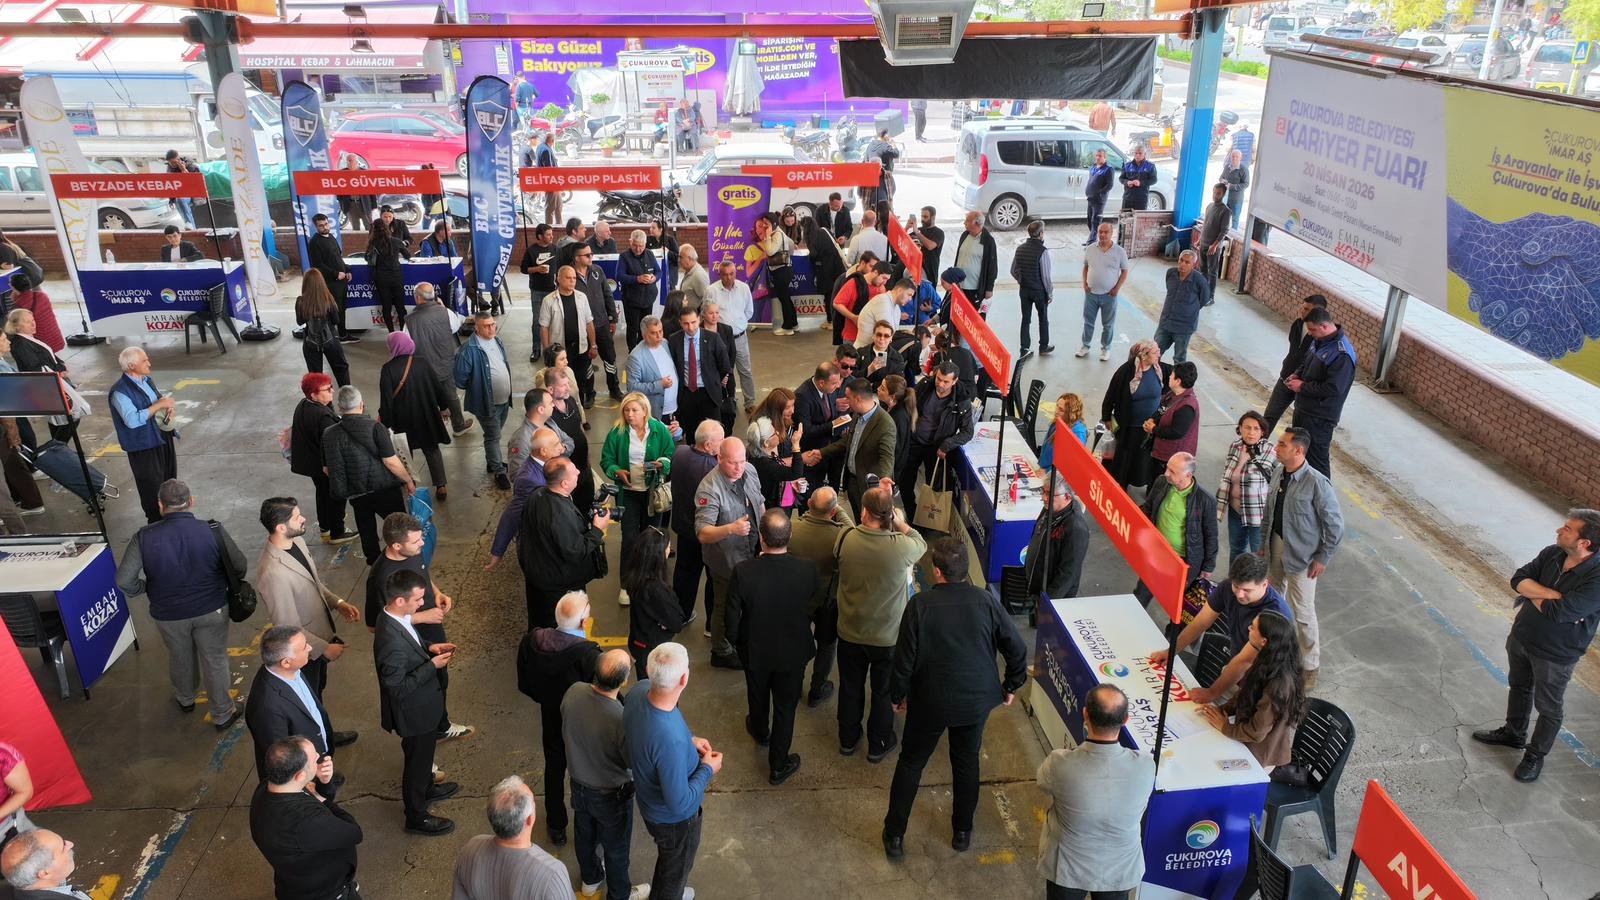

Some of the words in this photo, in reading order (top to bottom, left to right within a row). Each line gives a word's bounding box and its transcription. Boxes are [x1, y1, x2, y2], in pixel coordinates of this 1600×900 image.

[521, 40, 554, 54] Size
[558, 40, 602, 54] Güzel
[301, 57, 330, 66] KEBAP
[346, 57, 394, 66] LAHMACUN
[1492, 146, 1501, 166] İş
[1503, 154, 1563, 180] Arayanlar
[1566, 168, 1580, 184] ile
[1576, 152, 1592, 166] AŞ
[1362, 144, 1428, 190] FUARI
[321, 178, 347, 188] BLC
[350, 174, 416, 188] GÜVENLİK
[525, 174, 565, 186] ELİTAŞ
[568, 176, 600, 184] GRUP
[602, 172, 651, 184] PLASTİK
[787, 170, 833, 182] GRATİS
[1302, 162, 1315, 177] 20
[1315, 165, 1347, 189] NİSAN
[1348, 178, 1375, 200] 2026
[70, 181, 135, 192] BEYZADE
[138, 180, 182, 191] KEBAP
[722, 188, 756, 200] gratis
[474, 198, 489, 234] BLC
[1338, 229, 1375, 254] EMRAH
[134, 296, 146, 304] AŞ
[146, 322, 184, 330] KOZAY
[1089, 480, 1130, 543] SİLSAN
[80, 588, 116, 626] EMRAH
[82, 596, 118, 638] KOZAY
[1136, 698, 1156, 714] AŞ
[1166, 848, 1232, 864] ÇUKUROVA
[1165, 858, 1232, 870] BELEDİYESİ
